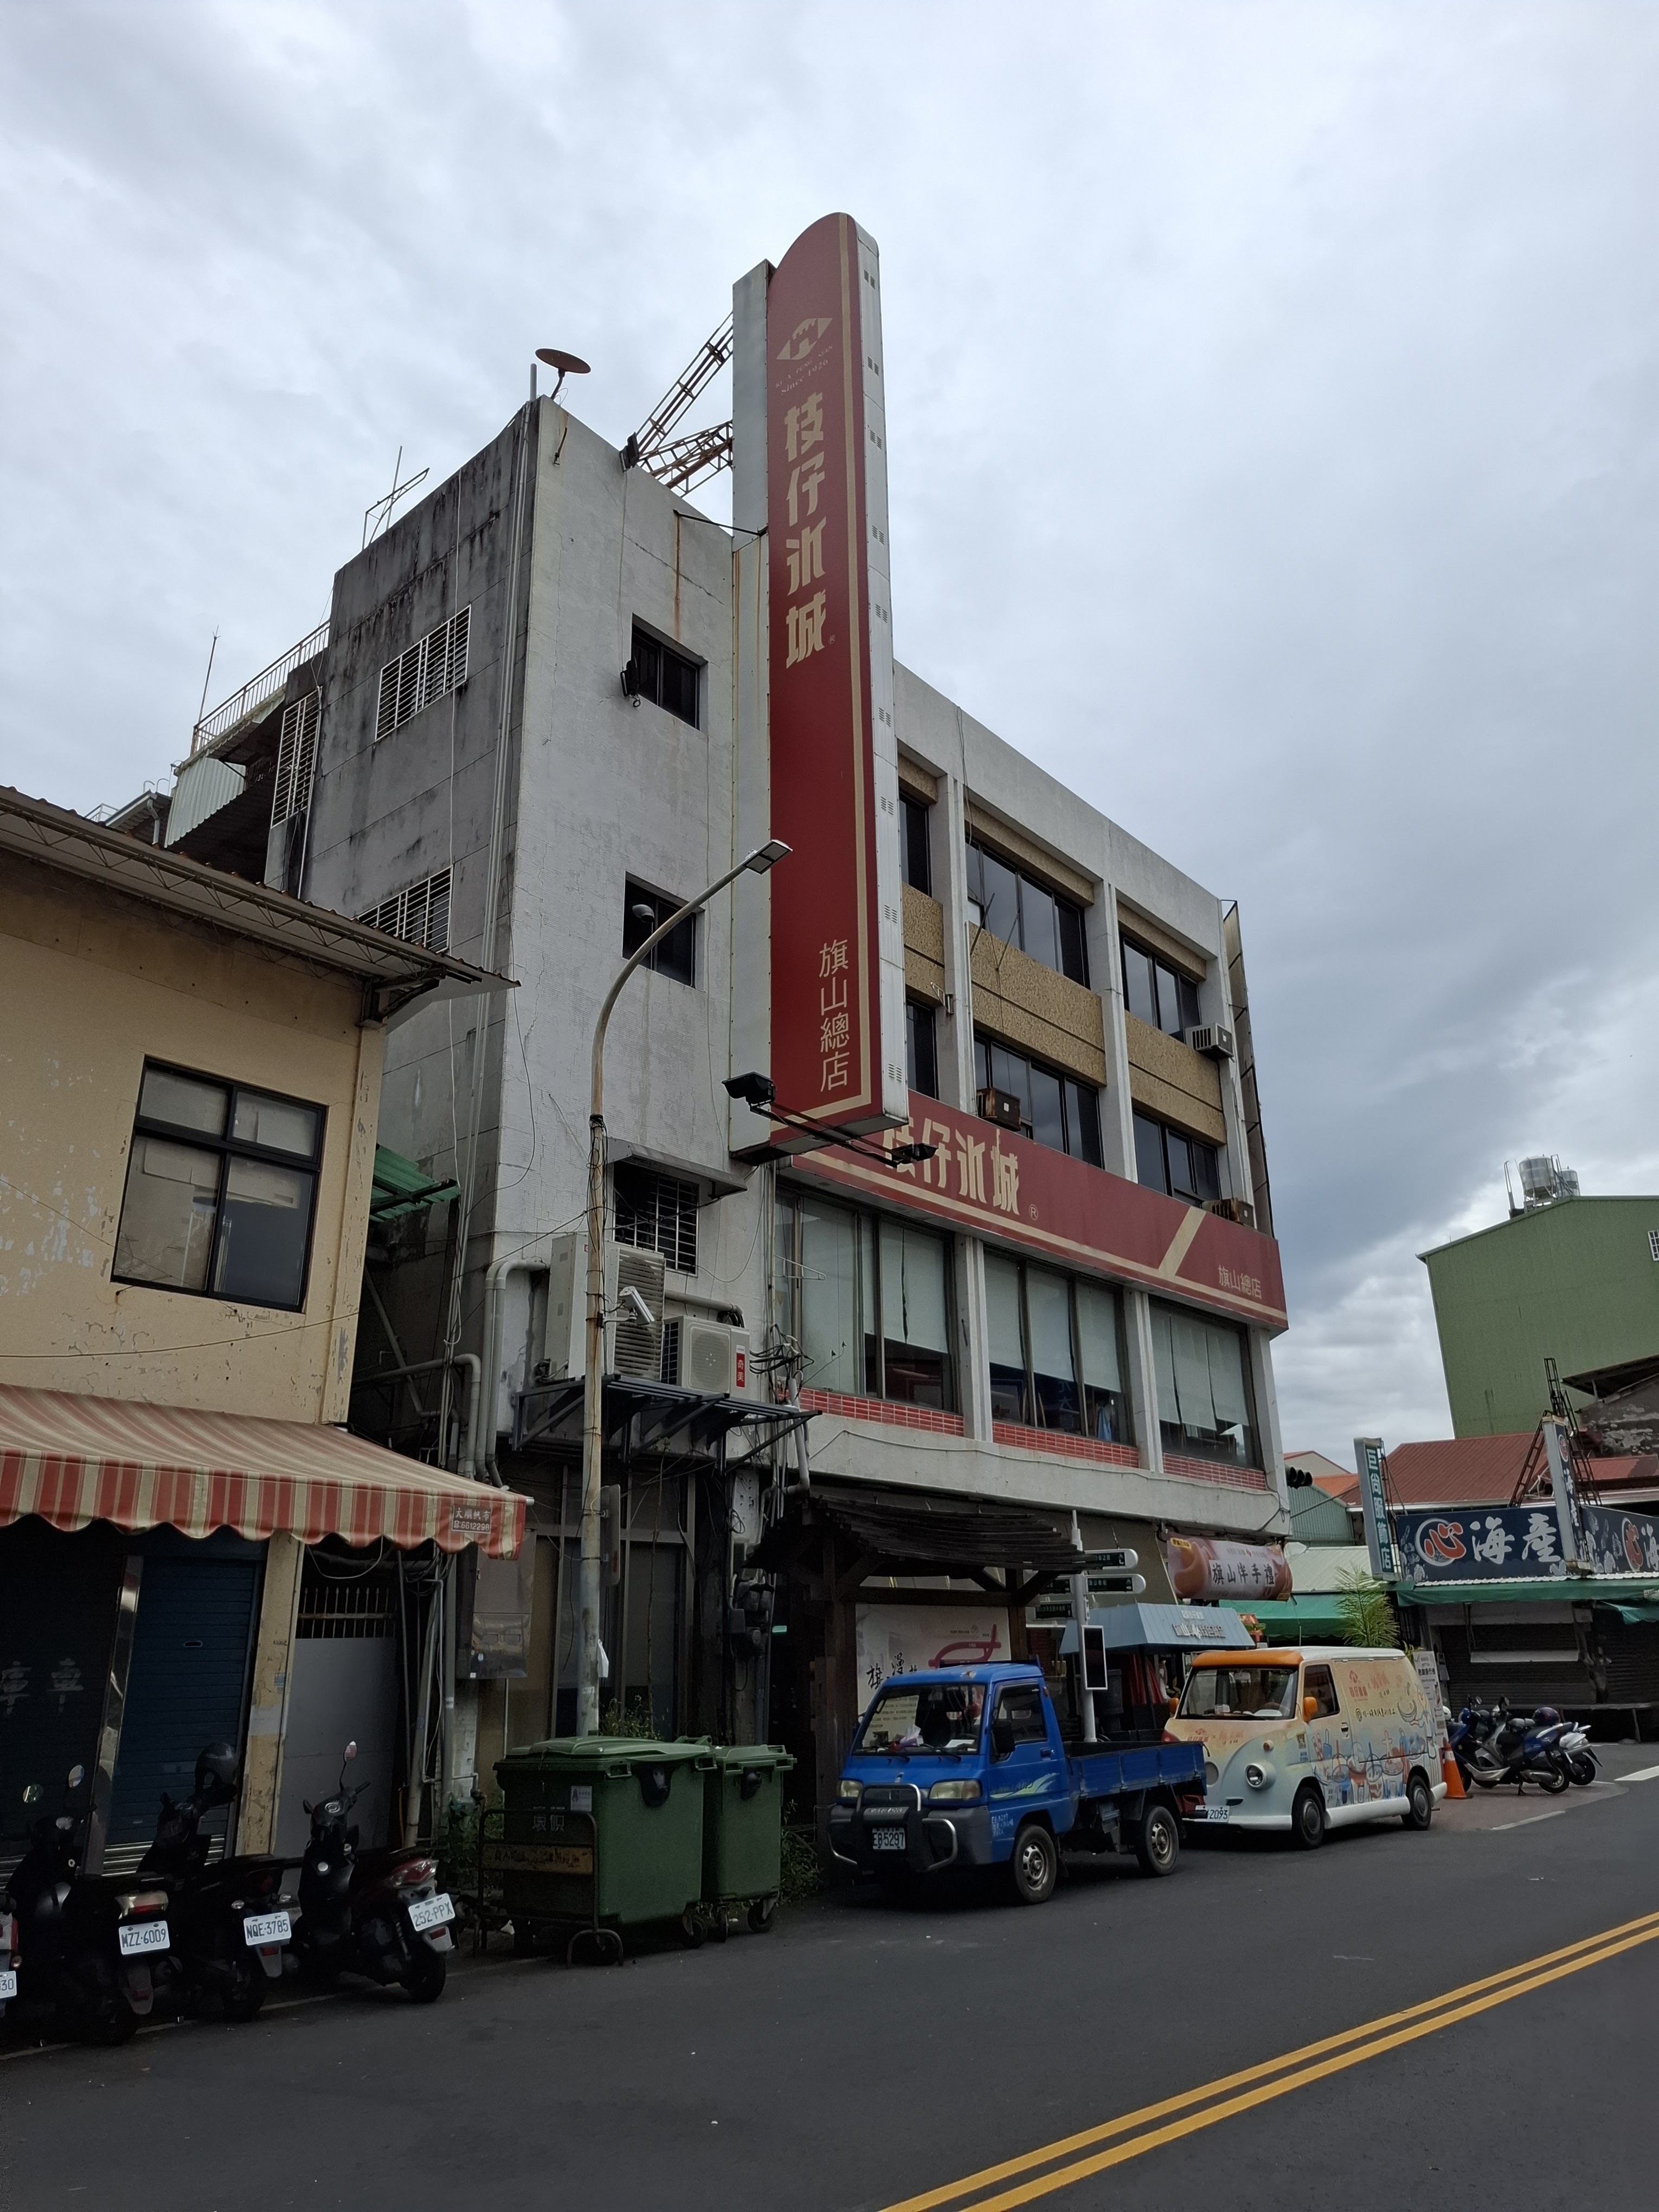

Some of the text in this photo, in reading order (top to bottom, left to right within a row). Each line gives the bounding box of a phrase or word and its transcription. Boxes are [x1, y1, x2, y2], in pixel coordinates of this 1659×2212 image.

[785, 391, 826, 669] 枝仔冰城
[819, 939, 850, 1092] 旗山總店
[1218, 1264, 1262, 1300] 旗山總店
[1212, 1562, 1275, 1585] 旗山伴手禮
[413, 1902, 453, 1927] 252-PPX
[121, 1928, 166, 1948] MZZ-6009
[246, 1919, 288, 1939] NQE-3785
[0, 1978, 14, 1991] 30
